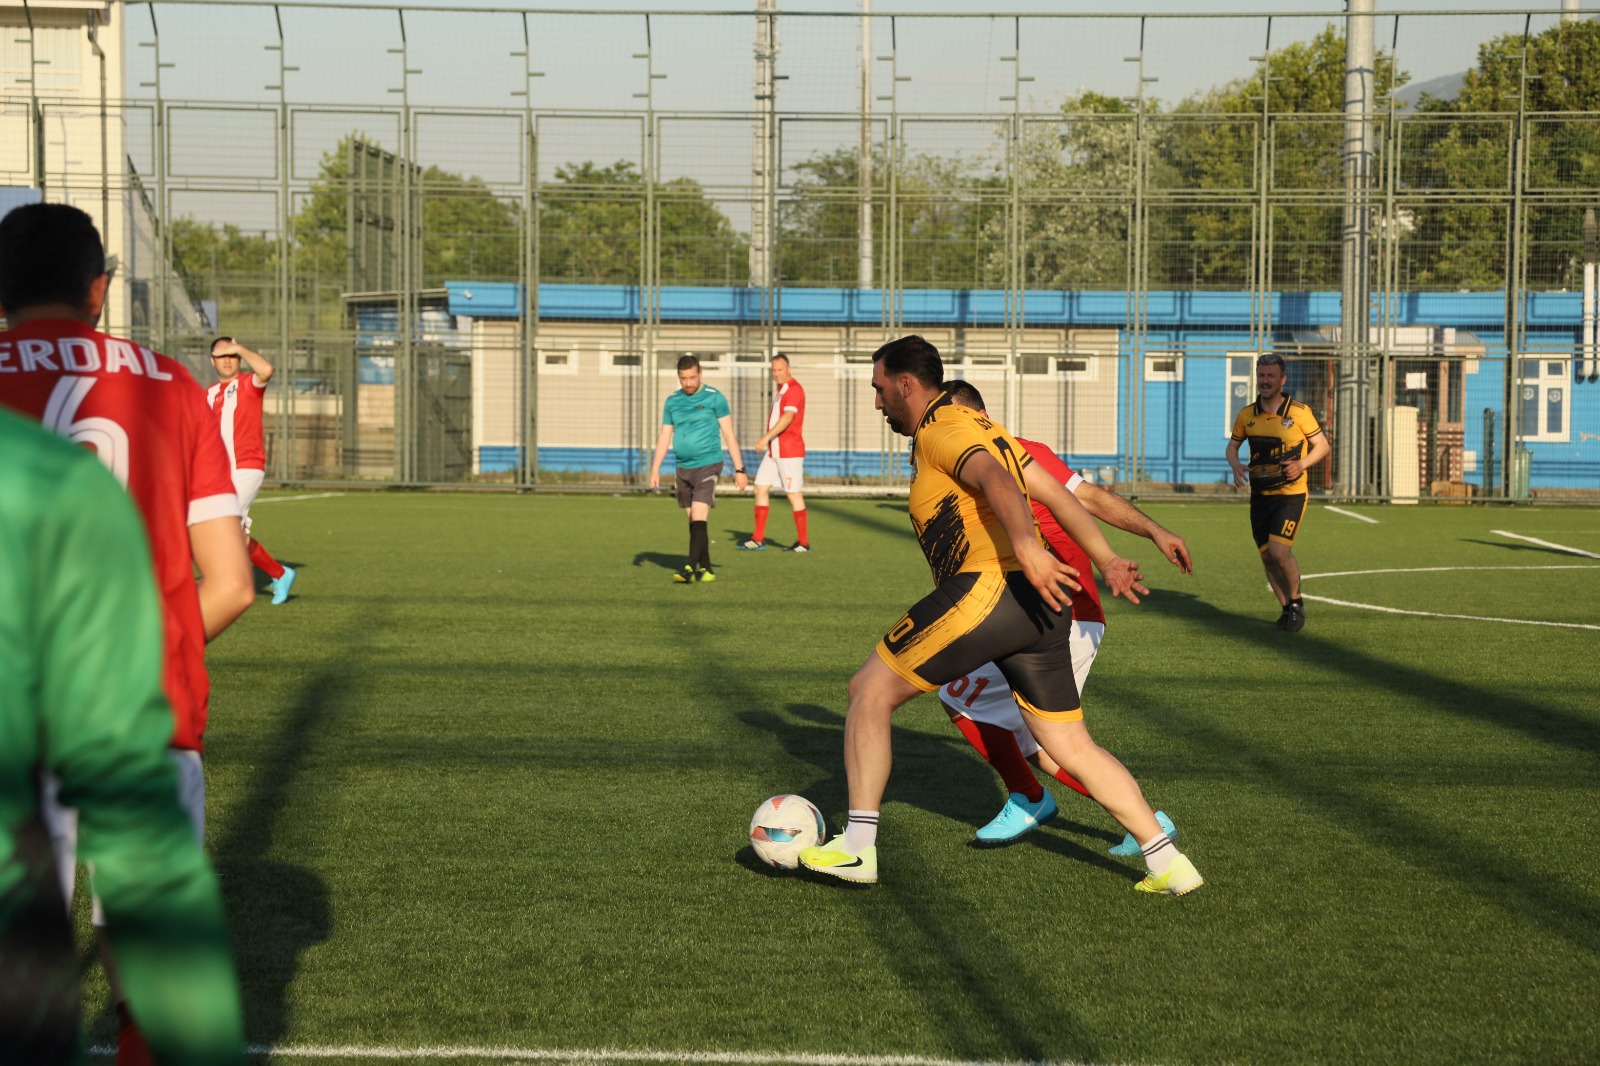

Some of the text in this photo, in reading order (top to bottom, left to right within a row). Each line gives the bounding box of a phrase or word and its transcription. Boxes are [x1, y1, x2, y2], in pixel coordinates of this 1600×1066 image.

[41, 375, 129, 493] 6
[785, 477, 793, 489] 7
[1281, 519, 1297, 537] 19
